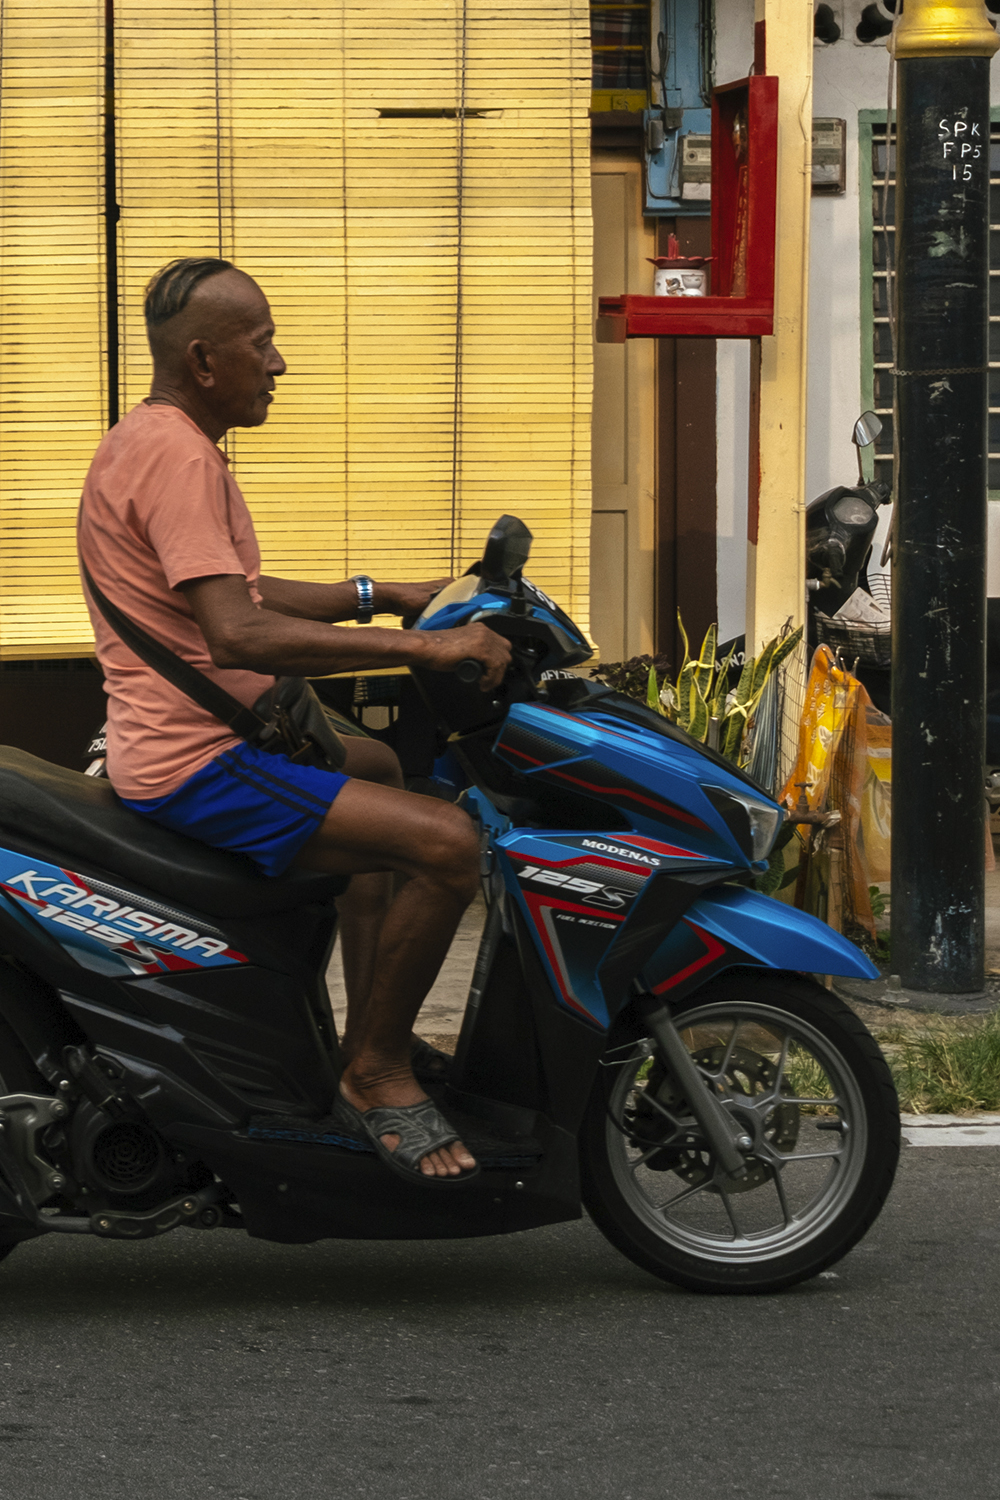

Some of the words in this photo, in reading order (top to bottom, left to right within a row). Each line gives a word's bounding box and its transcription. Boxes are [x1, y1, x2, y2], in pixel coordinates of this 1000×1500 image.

[952, 164, 972, 181] 15
[582, 839, 660, 866] MODENAS
[517, 865, 638, 909] 125S
[5, 869, 229, 958] KARISMA
[37, 904, 174, 965] 125S
